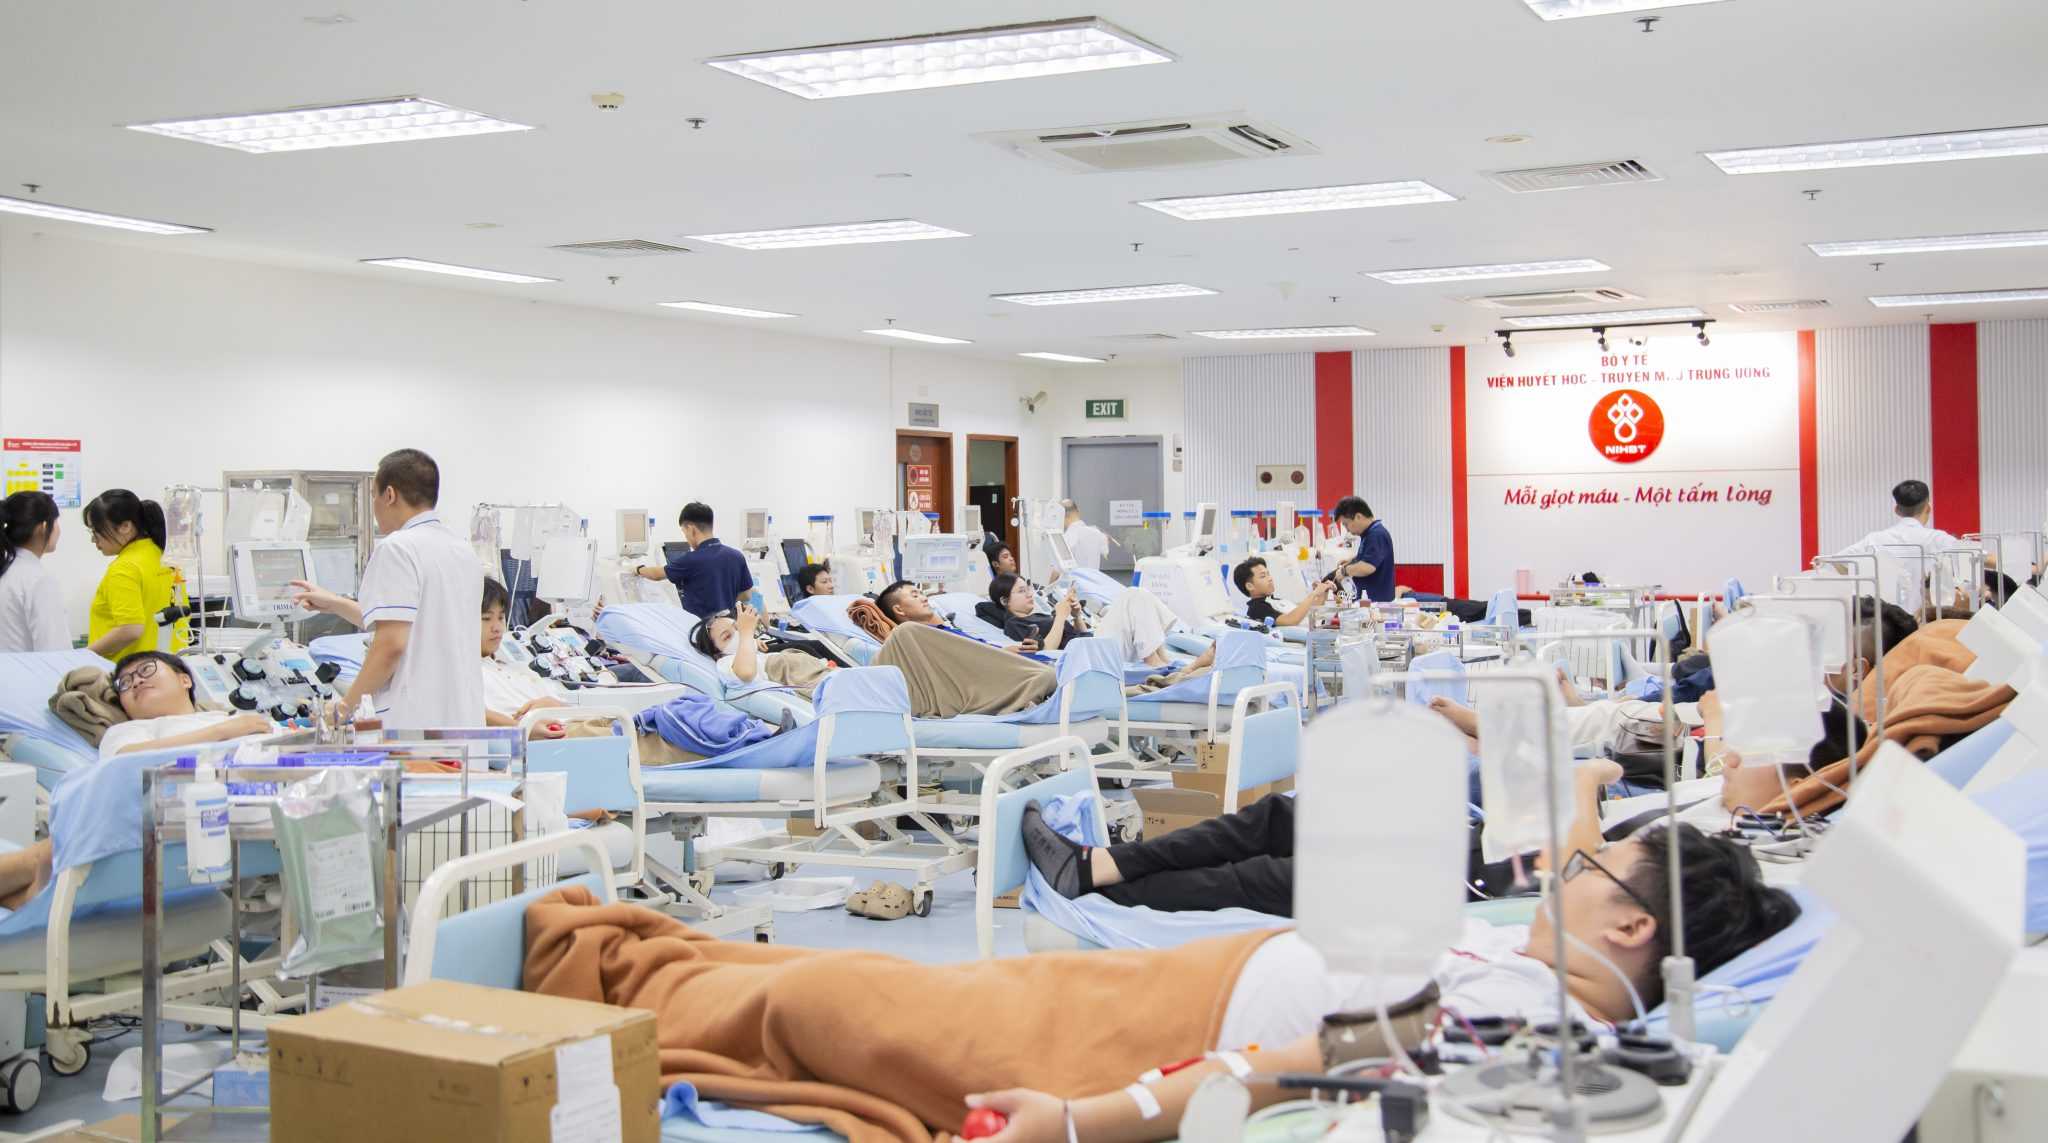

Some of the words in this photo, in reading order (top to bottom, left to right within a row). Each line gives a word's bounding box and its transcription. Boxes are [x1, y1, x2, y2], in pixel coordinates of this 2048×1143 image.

[1688, 368, 1730, 381] TRUNG
[1092, 402, 1118, 416] EXIT
[1605, 444, 1647, 455] NIHBT
[1504, 485, 1537, 505] Mỗi
[1540, 488, 1575, 510] giọt
[1578, 488, 1619, 505] máu
[1635, 486, 1672, 507] Một
[1678, 482, 1719, 503] tấm
[1726, 484, 1773, 506] lòng
